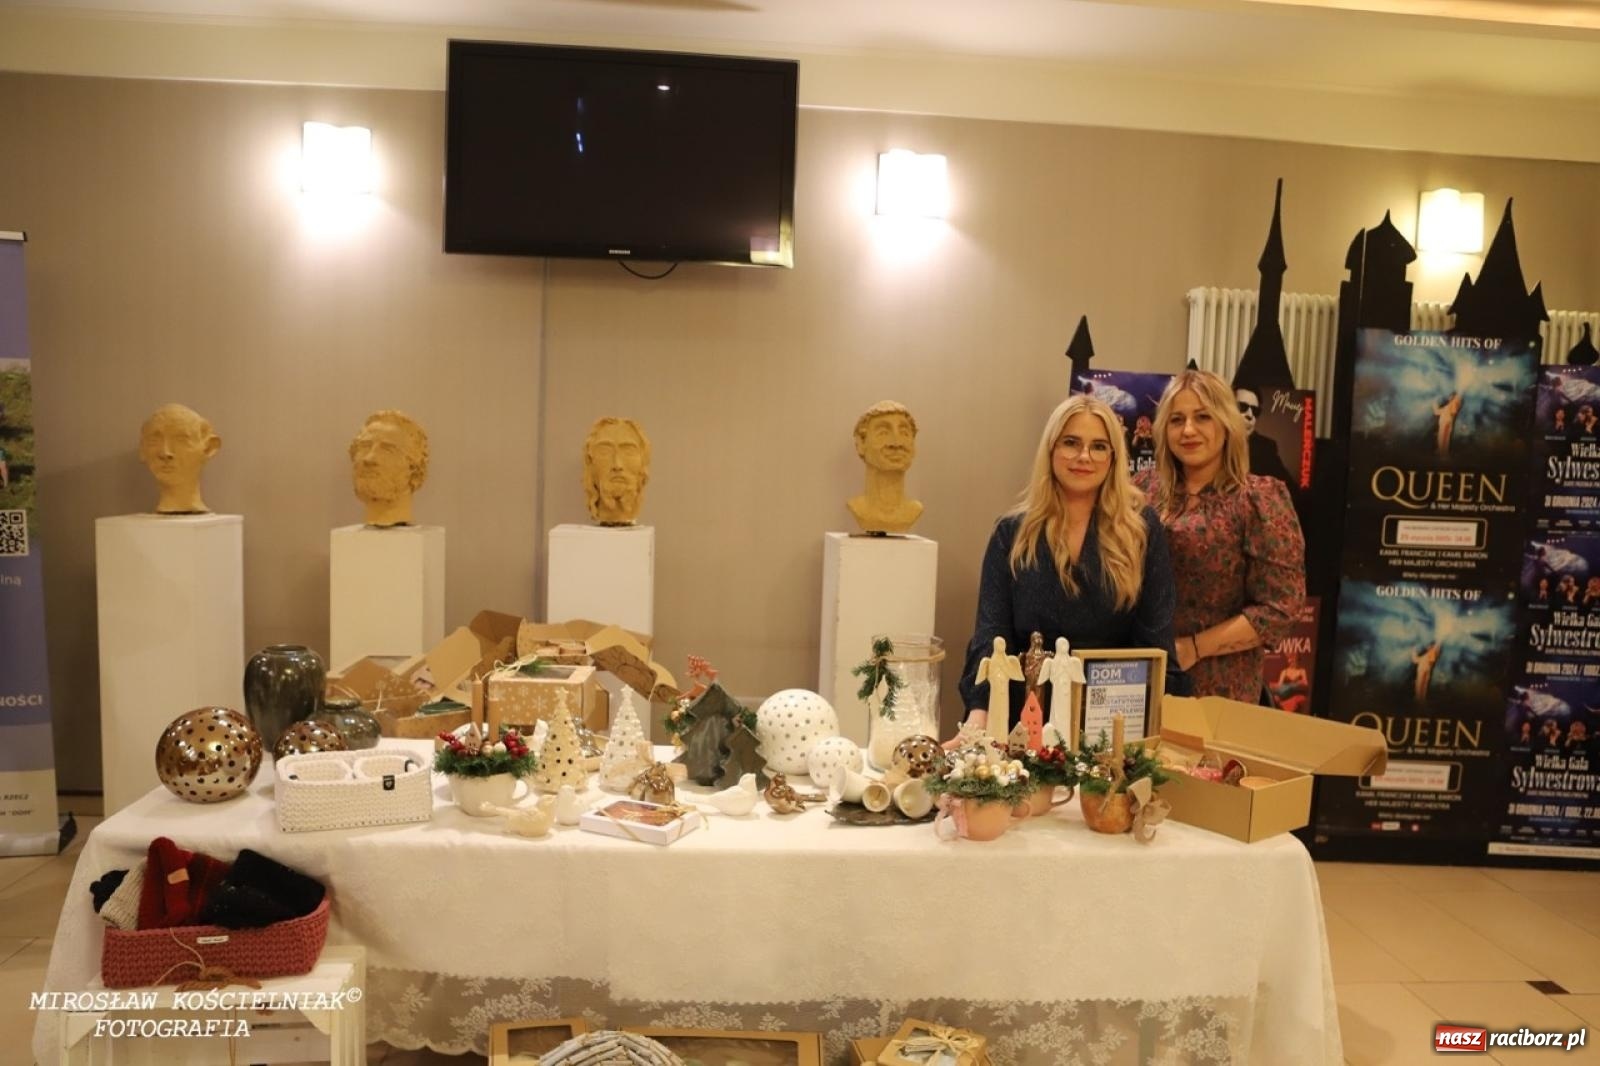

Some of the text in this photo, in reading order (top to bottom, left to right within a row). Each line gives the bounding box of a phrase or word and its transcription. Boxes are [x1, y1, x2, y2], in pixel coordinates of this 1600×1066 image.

[1394, 335, 1502, 350] GOLDEN HITS OF
[1371, 465, 1507, 509] QUEEN
[1376, 585, 1482, 599] GOLDEN HITS OF
[1554, 611, 1585, 627] Wielka
[1091, 668, 1121, 680] DOM
[1535, 755, 1589, 771] Wielka Gala
